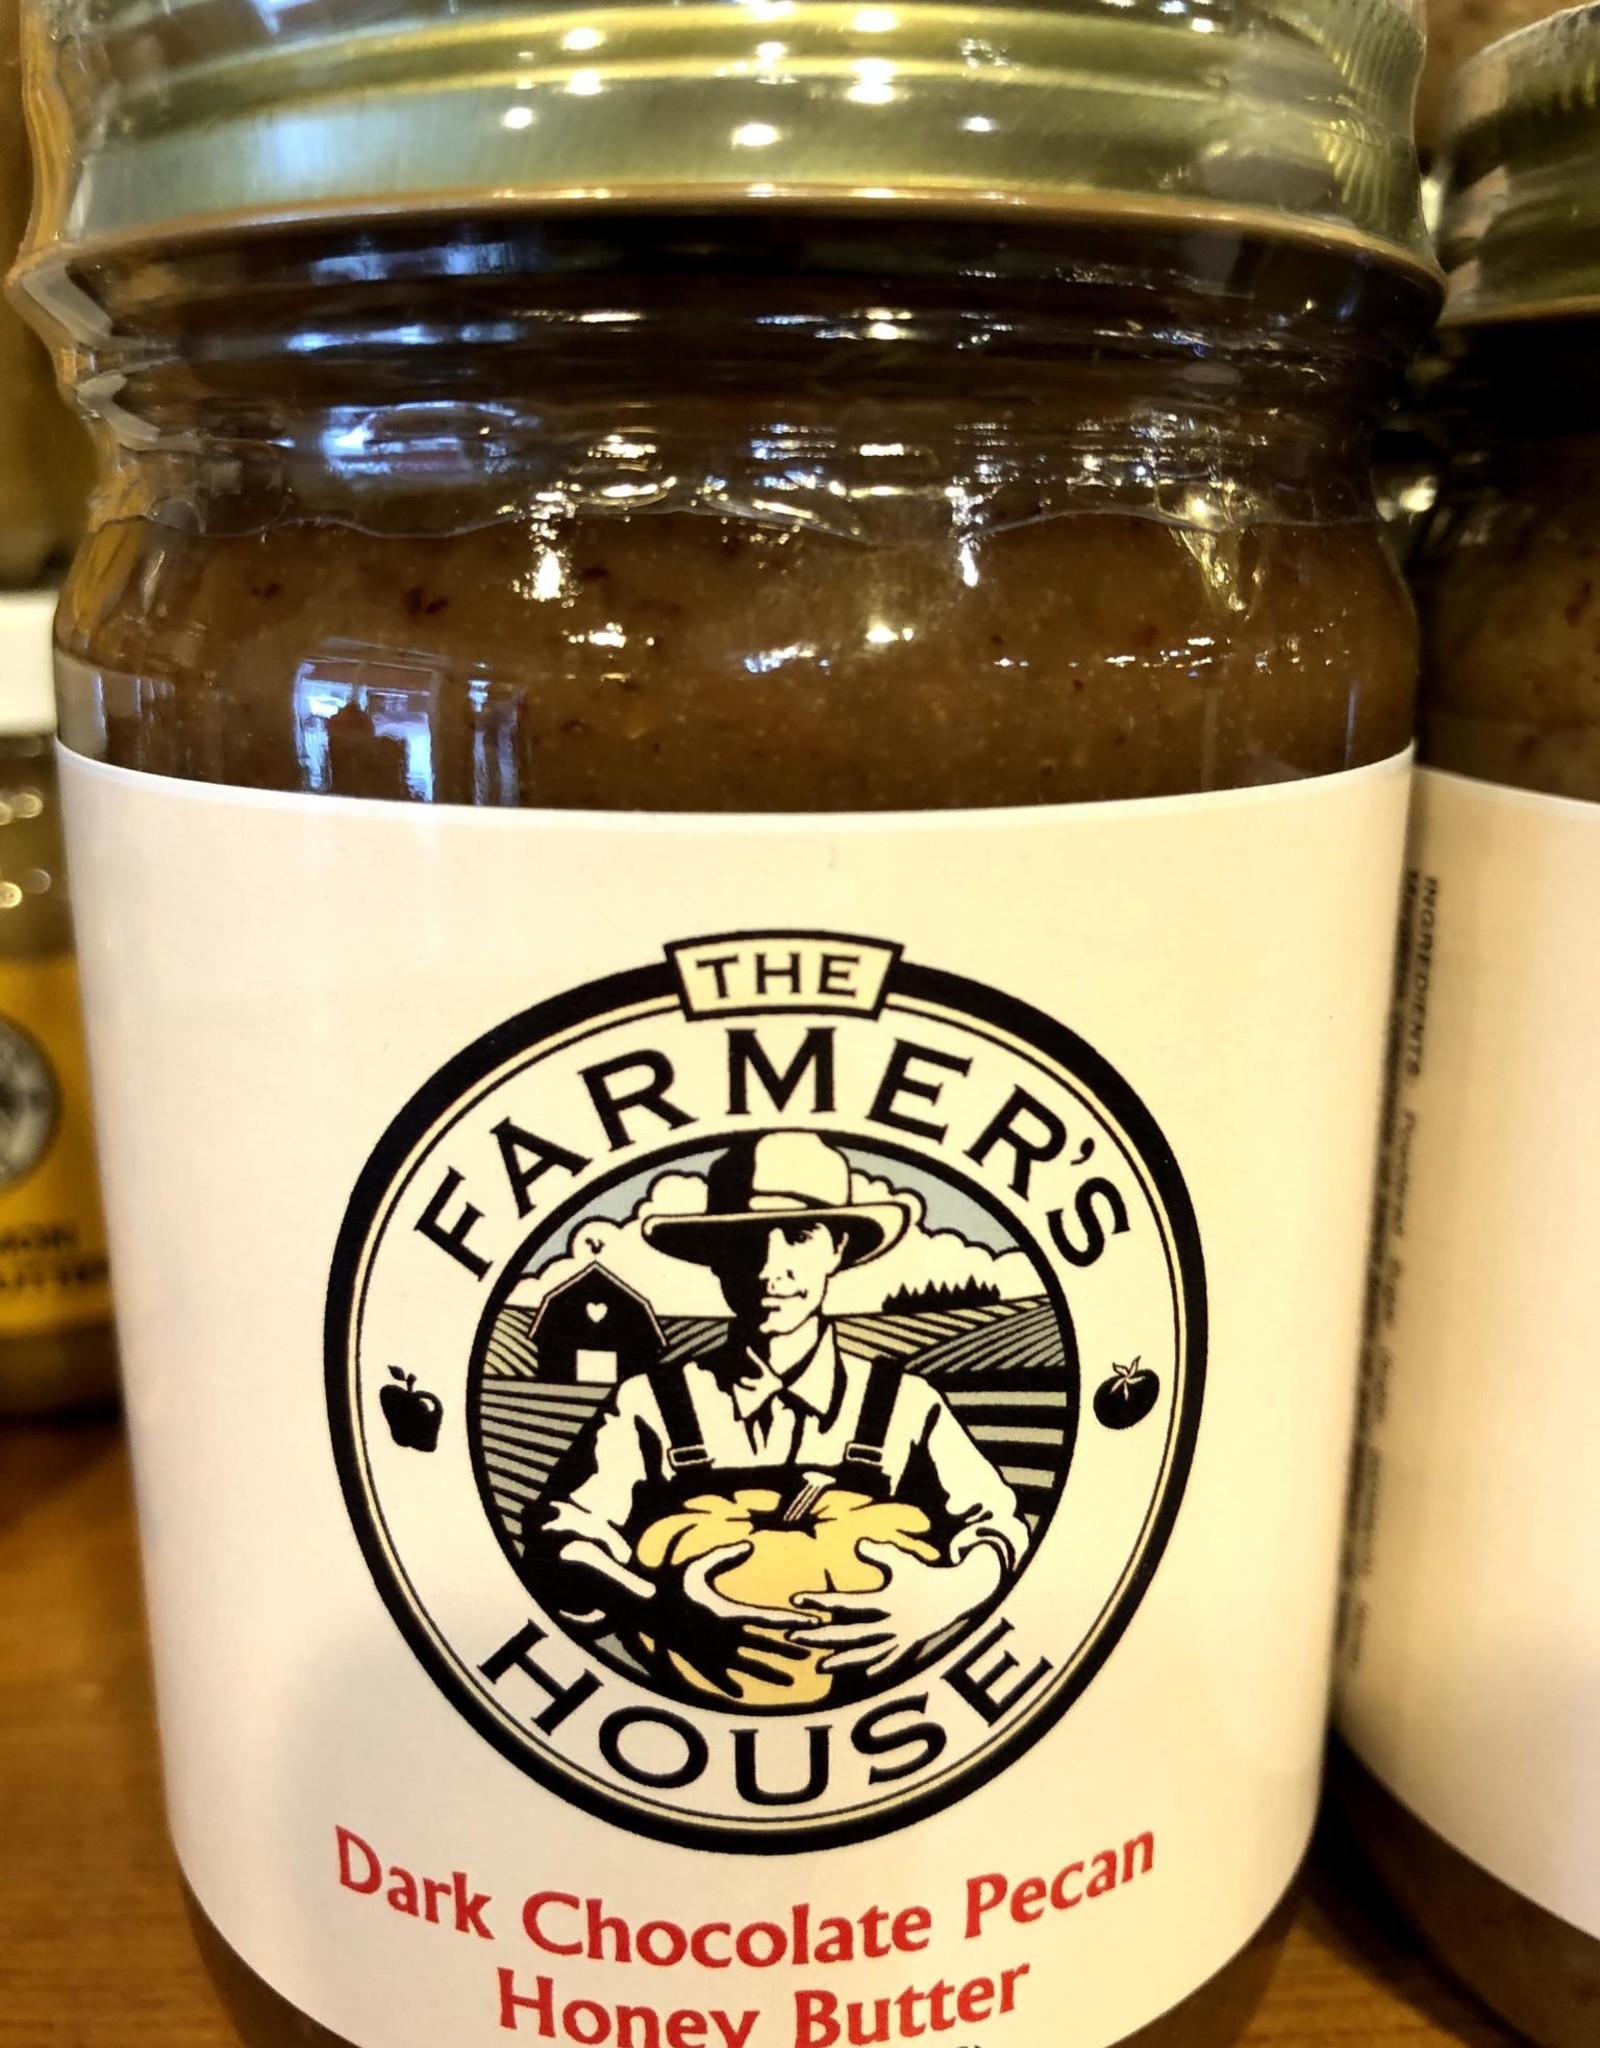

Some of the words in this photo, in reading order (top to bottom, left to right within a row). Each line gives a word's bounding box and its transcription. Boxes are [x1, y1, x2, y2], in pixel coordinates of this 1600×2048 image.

[695, 952, 861, 999] THE
[412, 1026, 1132, 1283] FARMER'S
[475, 1616, 1055, 1806] HOUSE
[334, 1825, 495, 1940] Dark
[521, 1890, 934, 1970] Chocolate
[963, 1830, 1156, 1940] Pecan
[496, 1965, 762, 2048] Honey
[792, 1962, 1032, 2048] Butter
